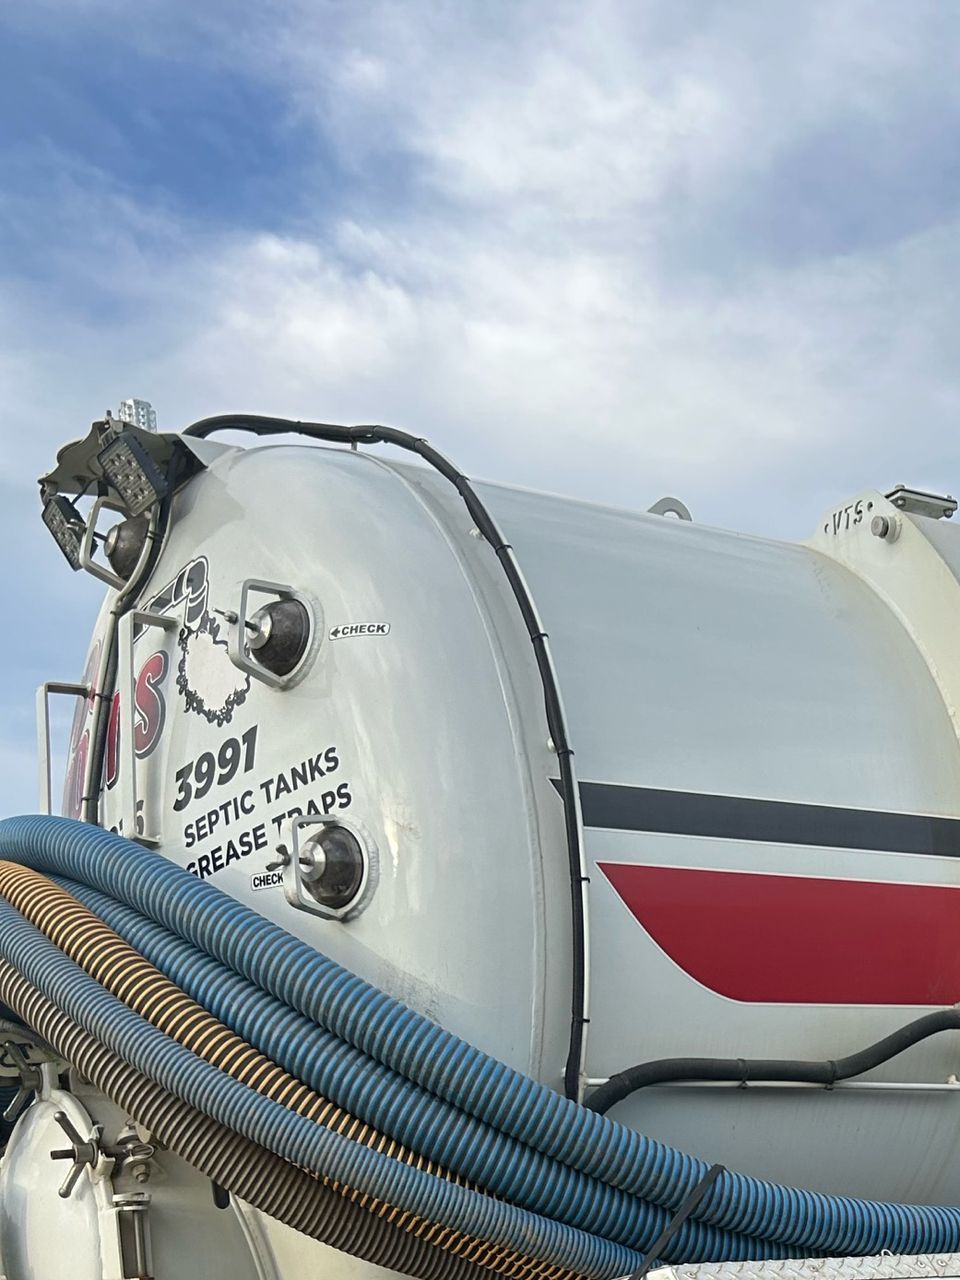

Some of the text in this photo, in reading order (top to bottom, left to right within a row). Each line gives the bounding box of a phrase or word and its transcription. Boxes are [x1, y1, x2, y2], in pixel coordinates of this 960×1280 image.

[341, 624, 386, 636] CHECK
[173, 725, 258, 812] 3991
[184, 790, 256, 848] SEPTIC
[260, 747, 339, 804] TANKS
[253, 873, 284, 888] CHECK
